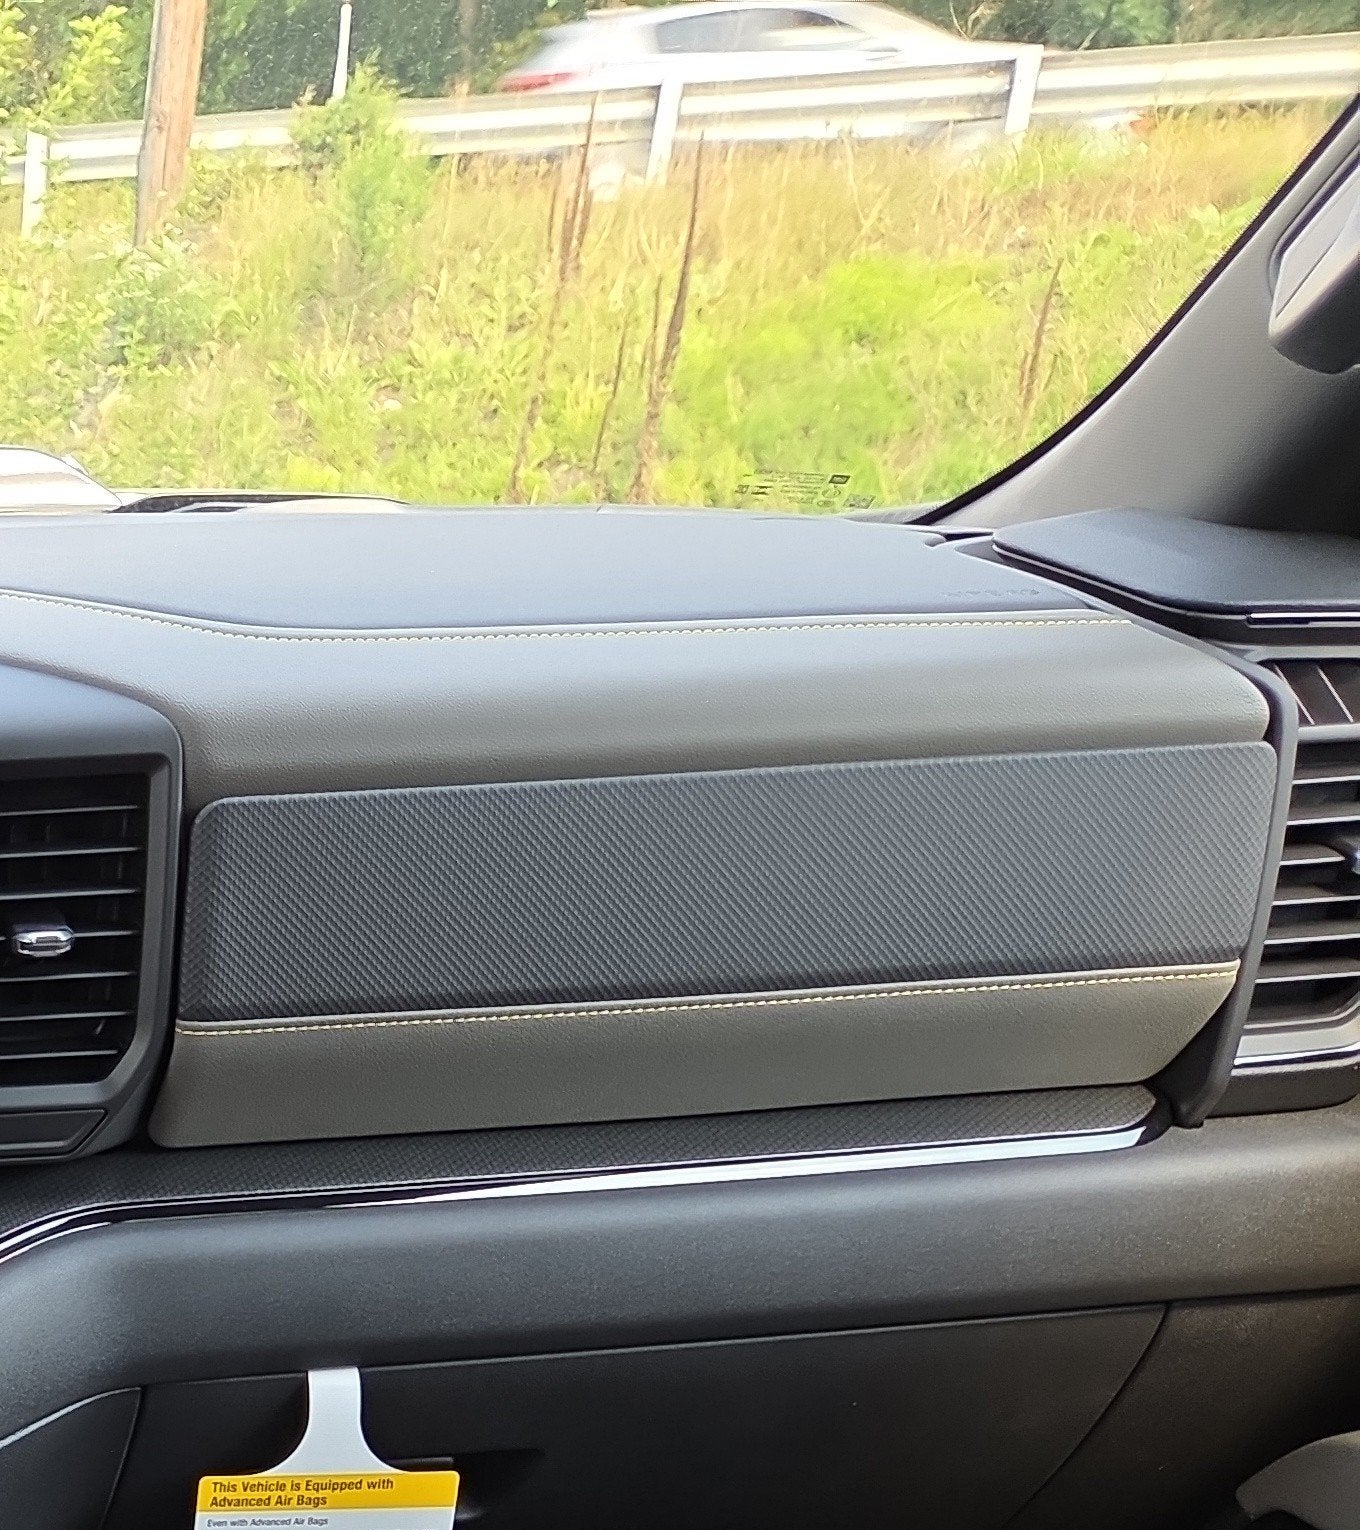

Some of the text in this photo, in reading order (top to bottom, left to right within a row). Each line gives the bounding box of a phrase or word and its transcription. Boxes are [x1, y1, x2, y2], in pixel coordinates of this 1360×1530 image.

[212, 1478, 394, 1493] This Vehicle is Equipped with
[210, 1495, 327, 1508] Advanced Air Bags
[207, 1519, 228, 1527] Even
[250, 1518, 291, 1526] Advanced
[307, 1517, 328, 1526] Bags
